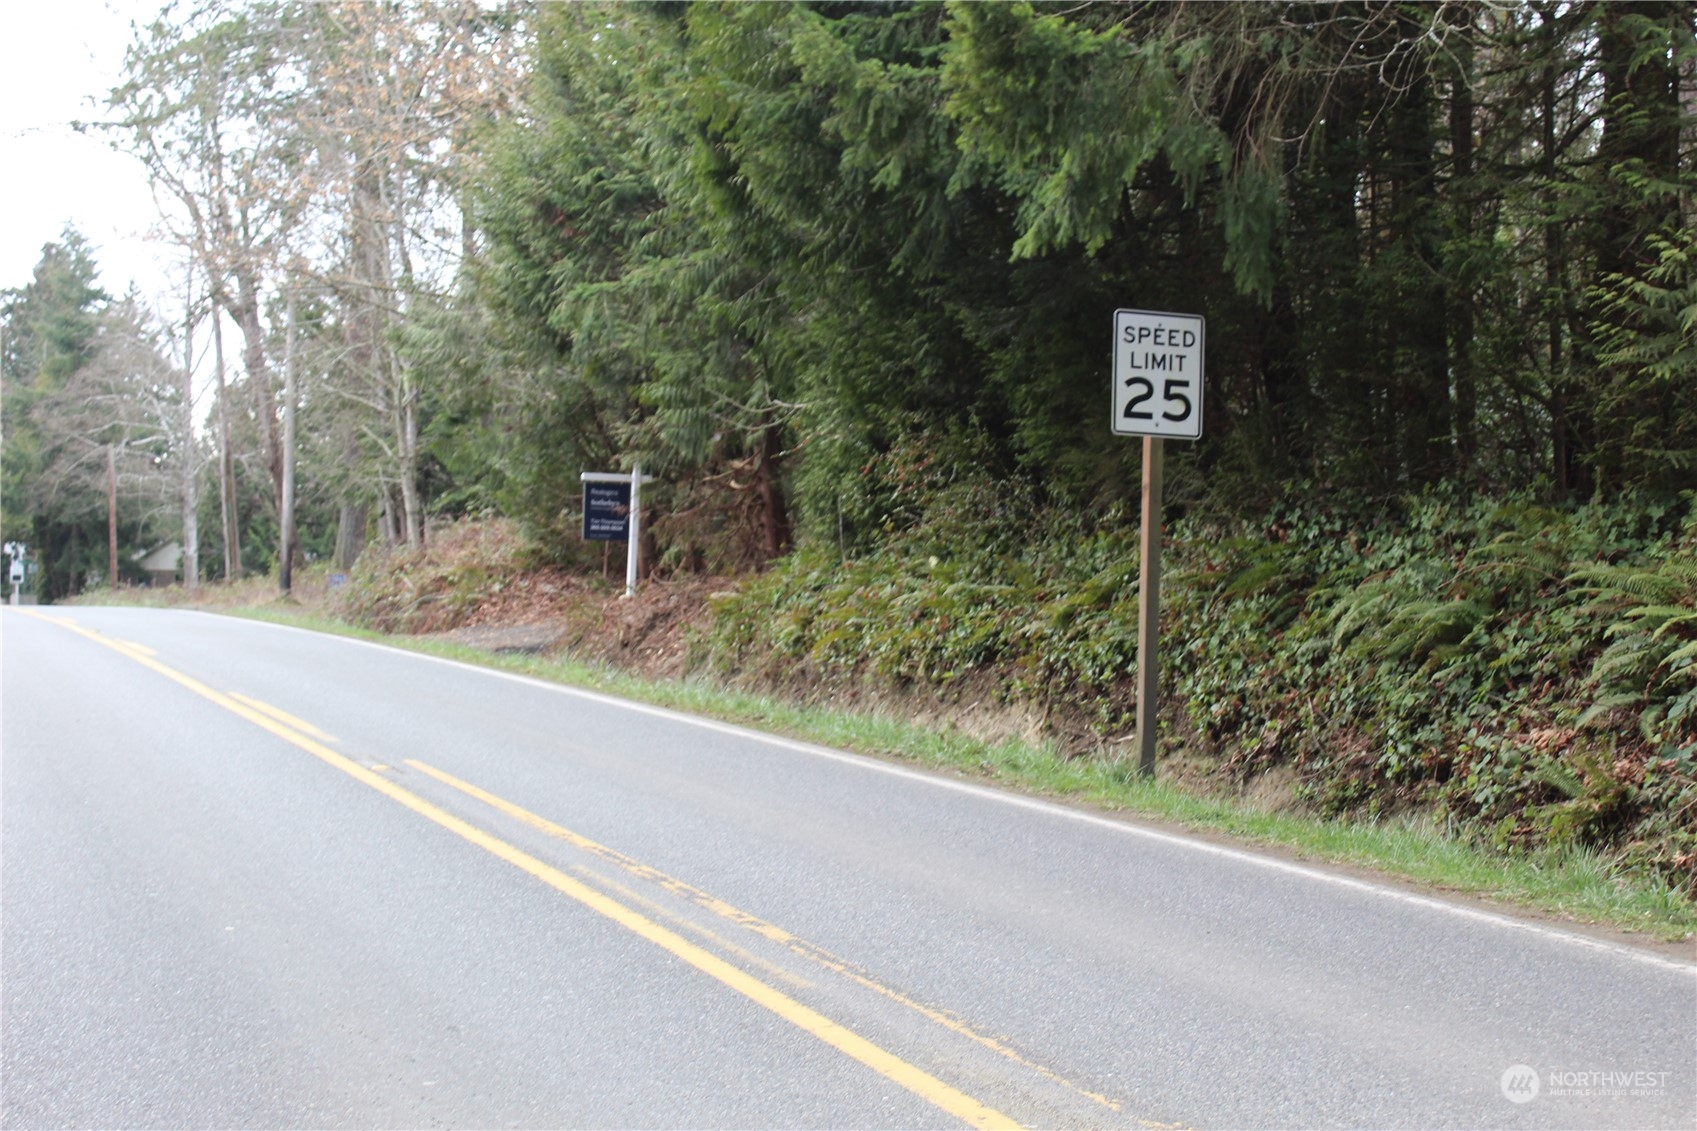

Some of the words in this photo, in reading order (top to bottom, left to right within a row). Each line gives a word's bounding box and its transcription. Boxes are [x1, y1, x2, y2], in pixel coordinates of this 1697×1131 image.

[1123, 326, 1196, 348] SPEED
[1130, 351, 1187, 372] LIMIT
[1123, 376, 1192, 422] 25
